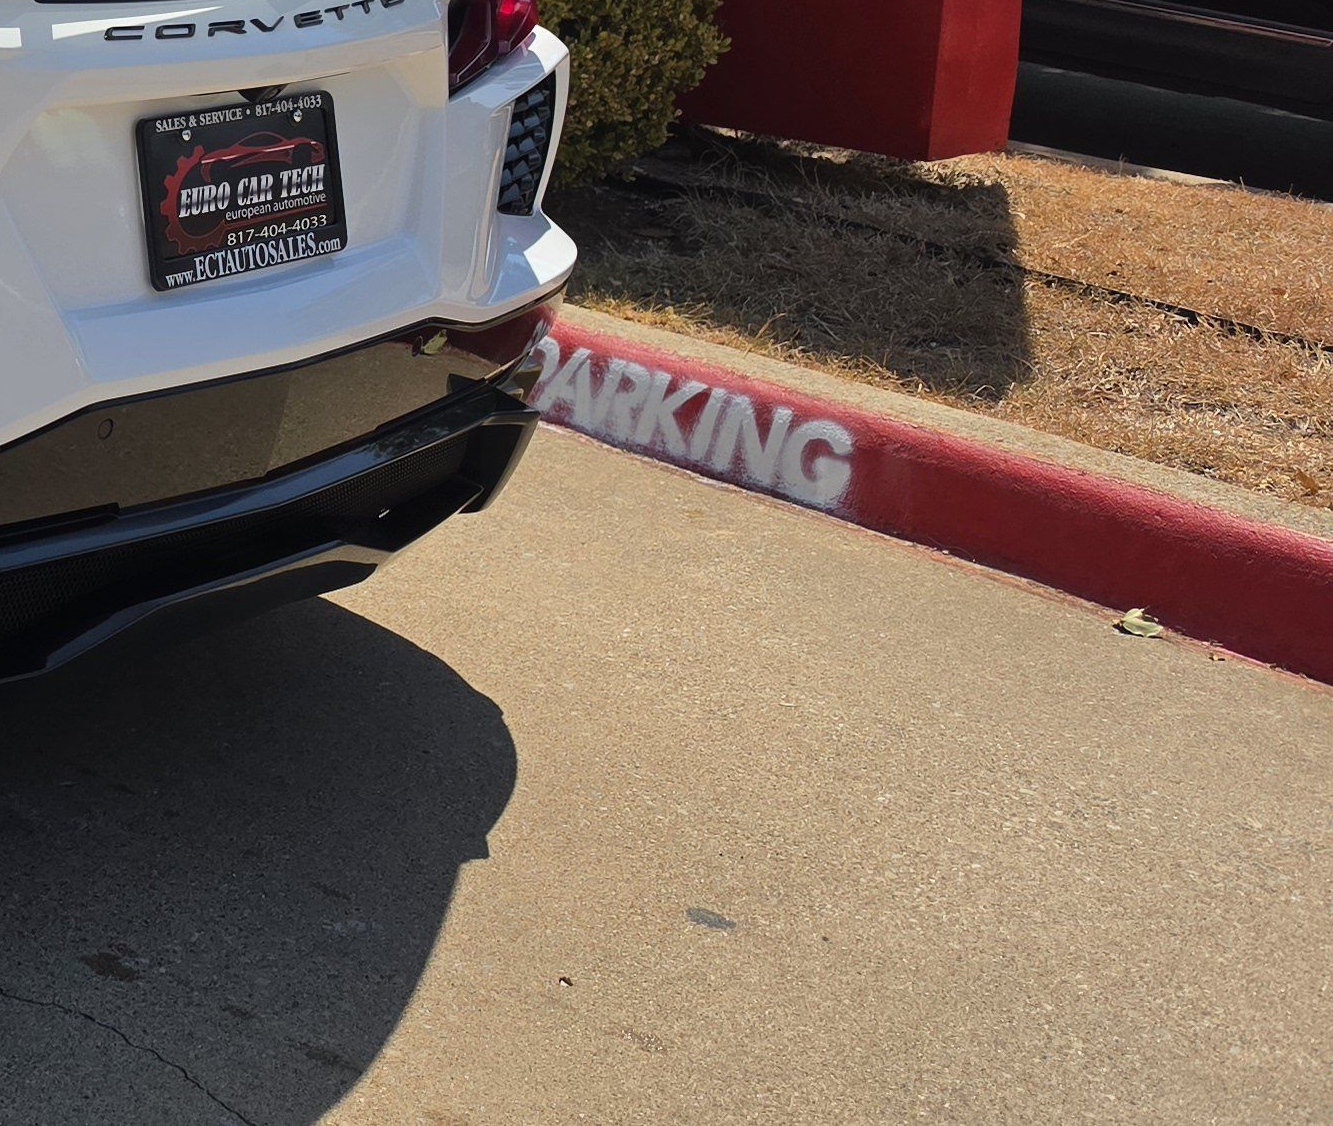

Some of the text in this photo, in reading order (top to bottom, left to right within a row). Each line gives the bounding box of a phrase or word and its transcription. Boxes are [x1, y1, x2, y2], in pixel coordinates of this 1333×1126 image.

[155, 94, 322, 133] SALES & SERVICE 817-404-4033
[178, 164, 326, 218] EURO CAR TECH
[225, 192, 327, 222] european automotive
[226, 214, 328, 246] 817-404-4033
[165, 231, 342, 288] www.ECTAUTOSALES.com
